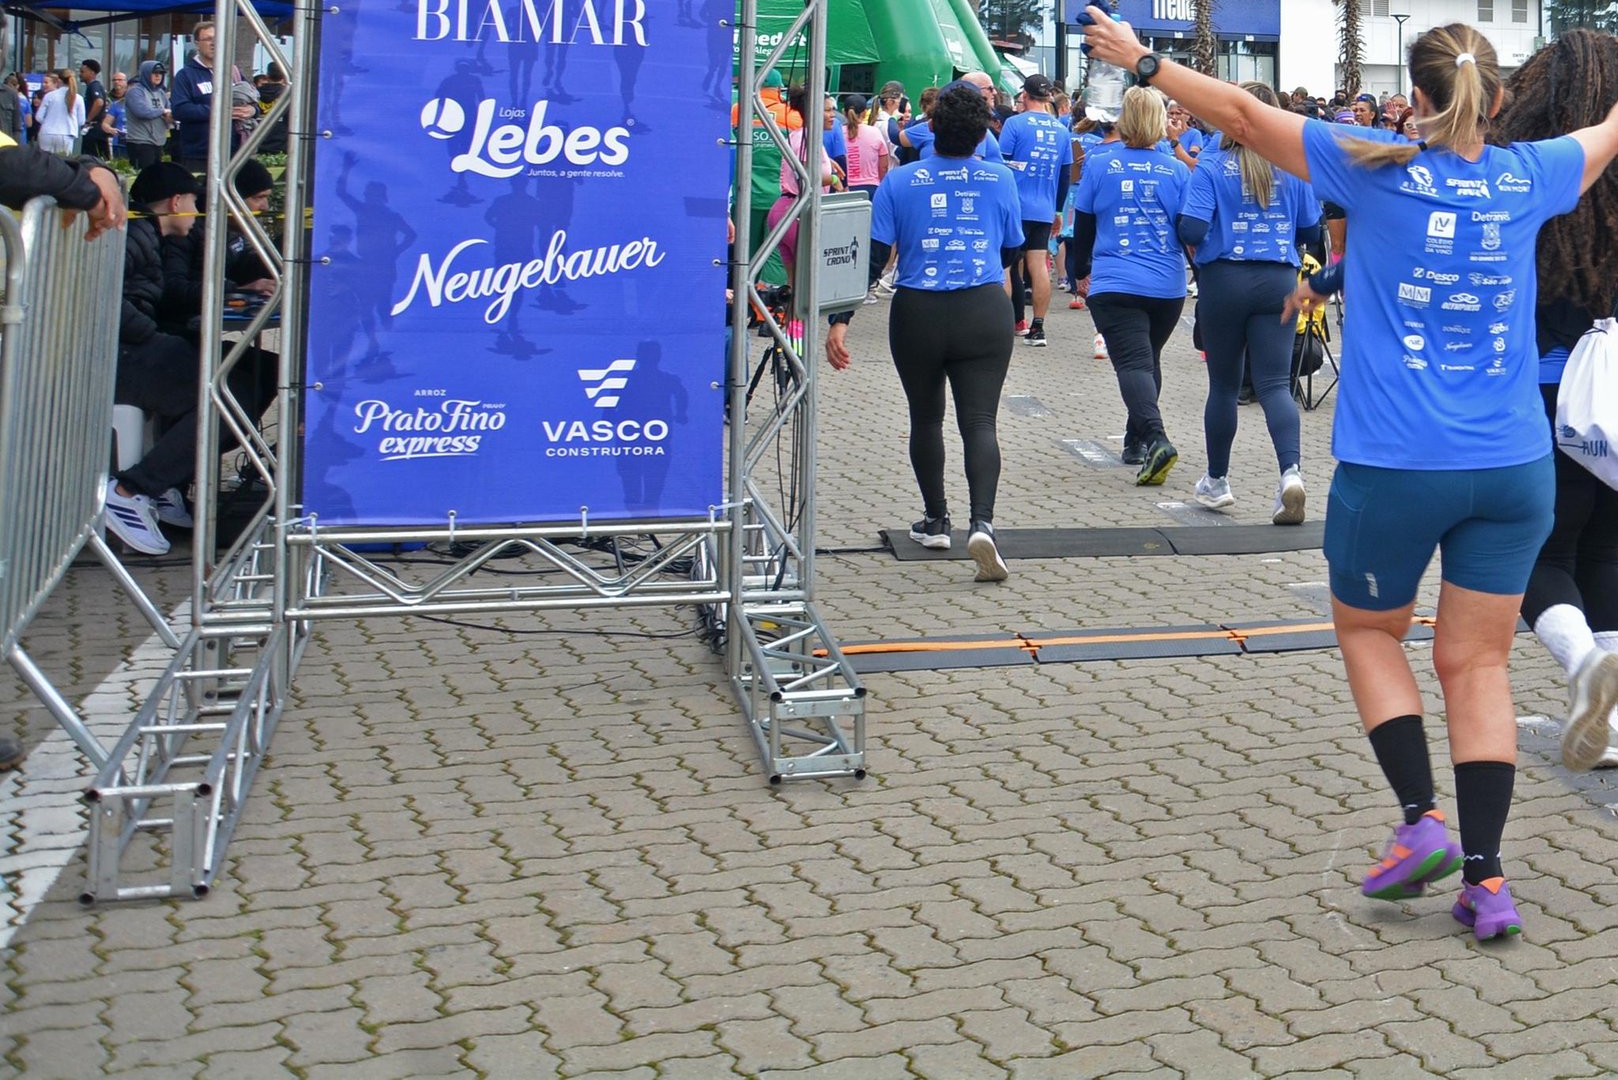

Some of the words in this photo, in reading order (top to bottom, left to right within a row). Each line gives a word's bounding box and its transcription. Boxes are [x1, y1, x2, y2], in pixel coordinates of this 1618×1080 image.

[499, 107, 526, 118] Lojas
[451, 98, 631, 178] Lebes
[527, 169, 558, 178] Juntos,
[567, 169, 591, 179] gente
[593, 169, 625, 178] resolve.
[823, 246, 850, 257] SPRINT
[826, 255, 850, 267] CRONO
[391, 229, 665, 325] Neugebauer
[414, 389, 447, 397] ARROZ
[355, 400, 441, 434] Prato
[442, 400, 505, 434] Fino
[542, 419, 669, 442] VASCO
[379, 434, 480, 457] express
[545, 446, 665, 457] CONSTRUTORA
[1583, 440, 1607, 457] RUN
